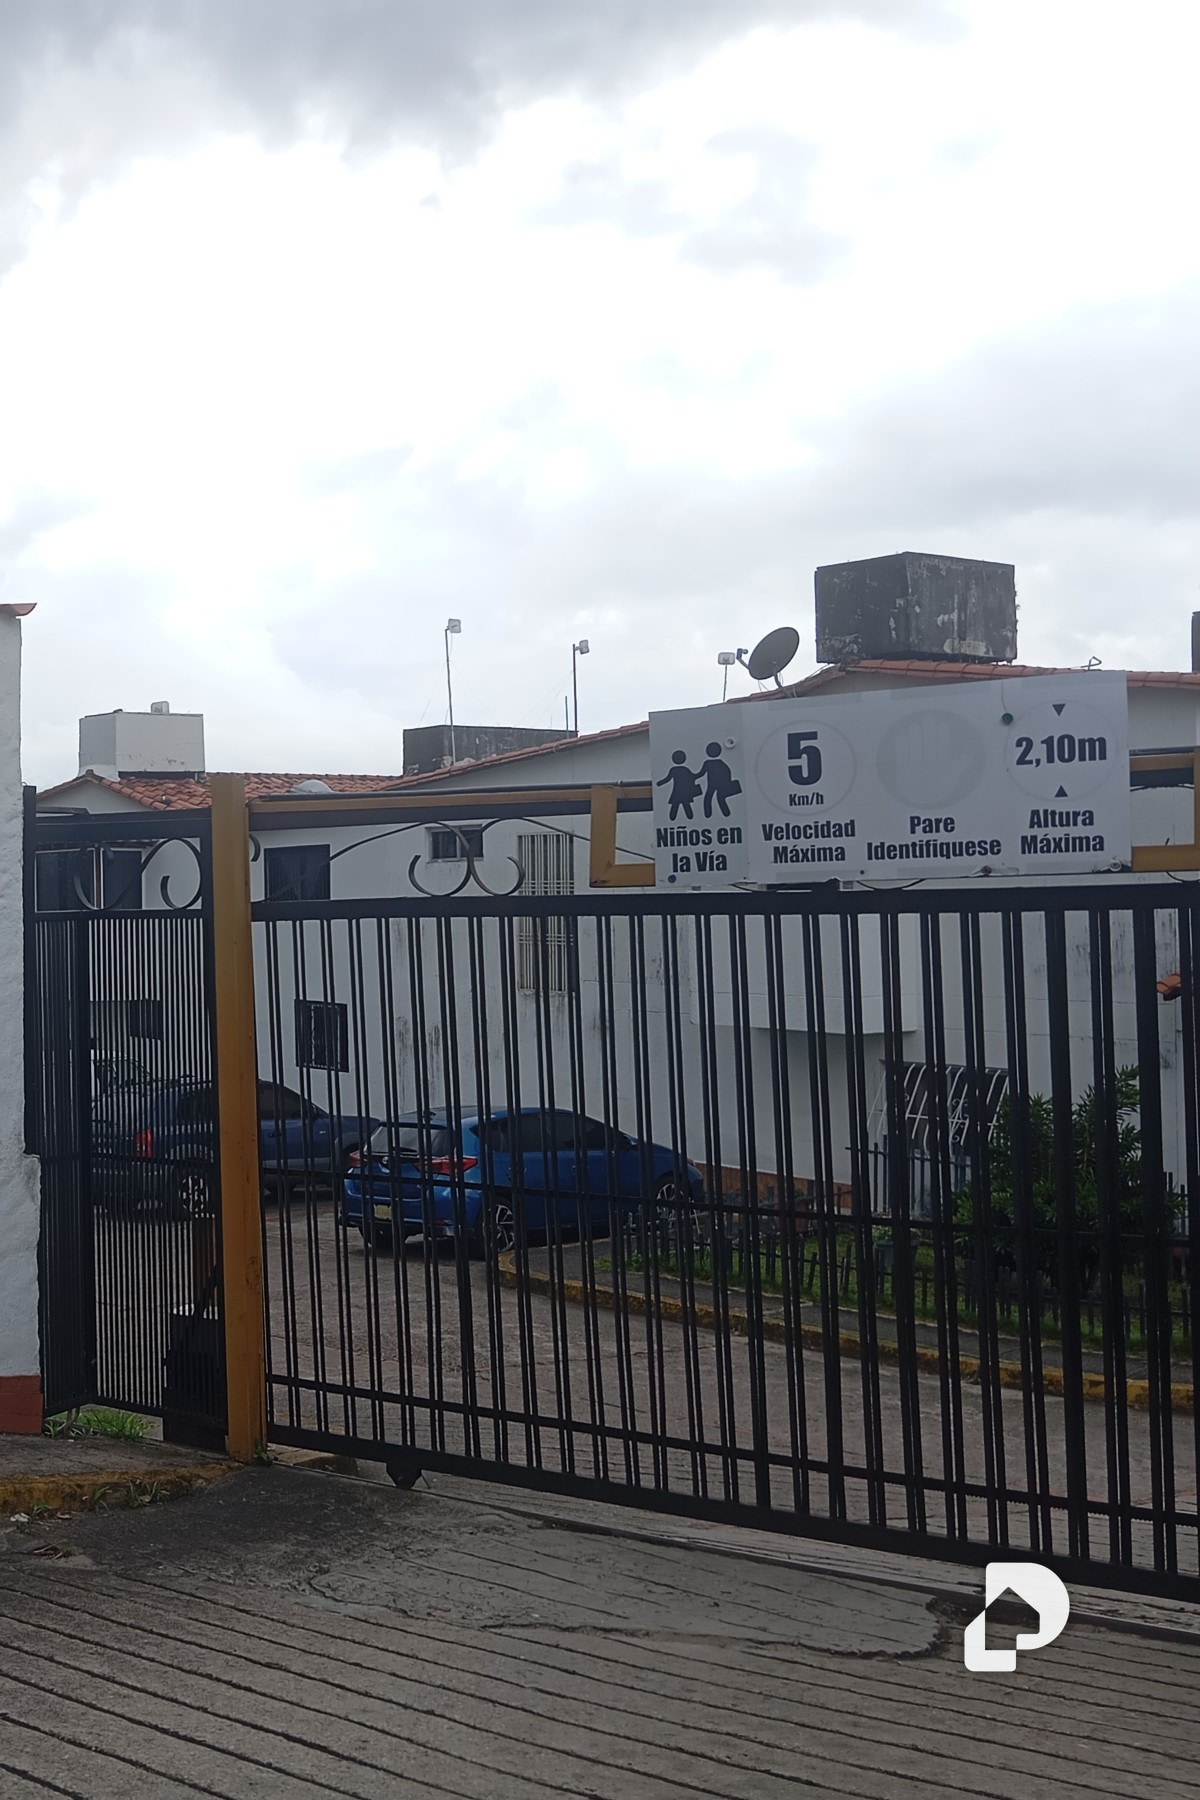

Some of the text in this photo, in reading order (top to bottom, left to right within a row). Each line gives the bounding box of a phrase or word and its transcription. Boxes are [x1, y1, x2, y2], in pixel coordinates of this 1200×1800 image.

[787, 731, 822, 786] 5
[1015, 734, 1107, 767] 2,10m
[788, 792, 824, 807] Km/h
[761, 819, 856, 841] Velocidad
[909, 816, 956, 834] Pare
[1029, 809, 1094, 829] Altura
[656, 825, 742, 847] Niños en
[1020, 832, 1104, 854] Máxima
[772, 844, 846, 864] Máxima
[866, 838, 1002, 861] Identifiquese
[672, 850, 727, 873] la Vía
